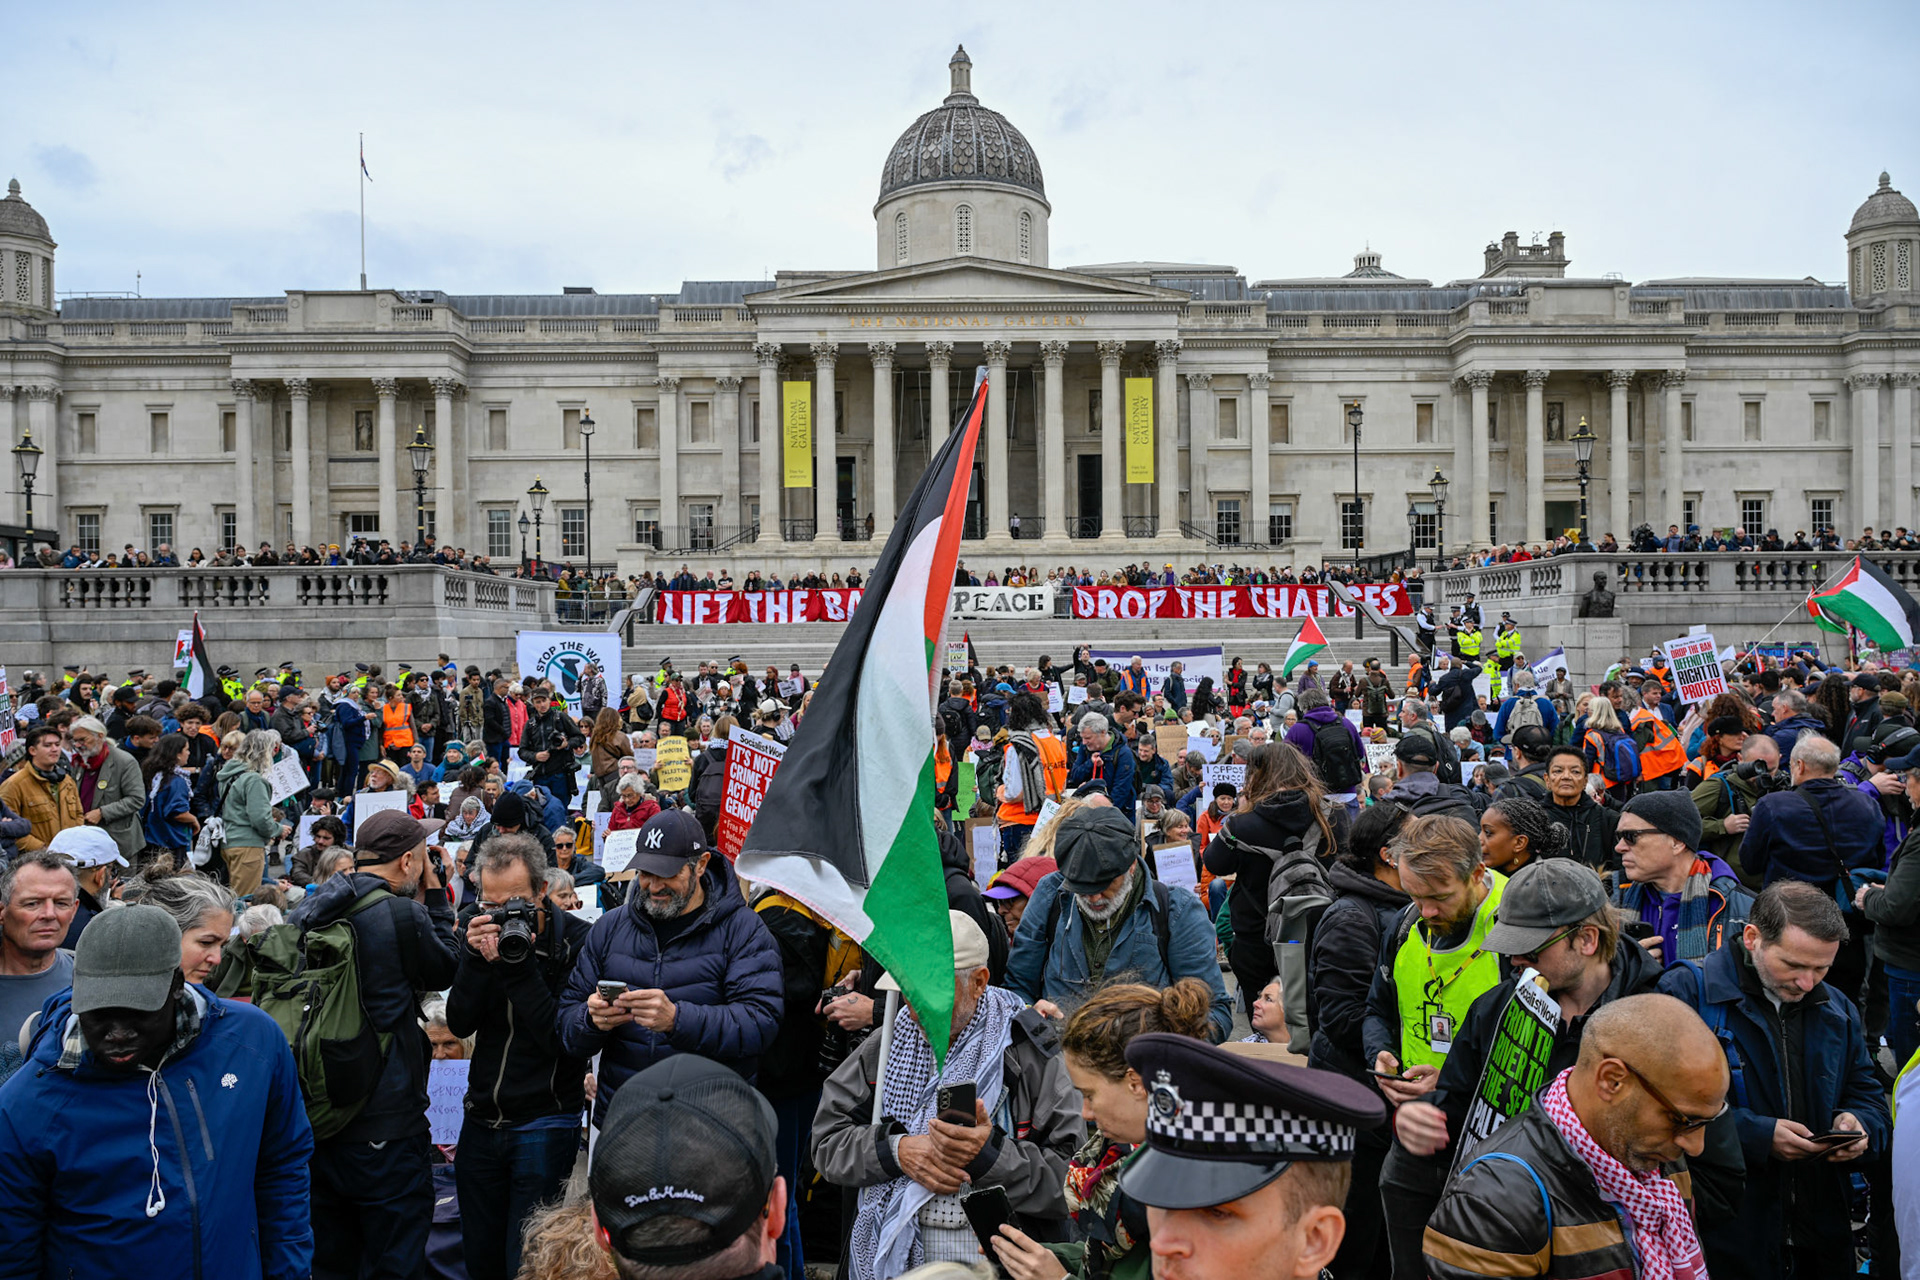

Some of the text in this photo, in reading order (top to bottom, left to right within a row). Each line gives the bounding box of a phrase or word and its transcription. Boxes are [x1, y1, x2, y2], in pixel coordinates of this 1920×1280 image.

[850, 315, 1088, 327] THE NATIONAL GALLERY
[790, 399, 798, 448] NATIONAL
[798, 399, 807, 449] GALLERY
[1132, 395, 1140, 445] NATIONAL
[1141, 396, 1149, 445] GALLERY
[664, 590, 862, 624] LIFT THE BA
[953, 591, 1044, 612] PEACE
[1074, 586, 1167, 619] DROP
[1175, 587, 1237, 618] THE
[536, 641, 605, 674] STOP THE WAR
[1671, 641, 1712, 659] DROP THE BAN
[1673, 651, 1715, 670] DEFEND THE
[1677, 663, 1720, 685] RIGHT TO
[1681, 678, 1724, 700] PROTEST
[731, 743, 776, 777] IT'S NOT
[1206, 765, 1244, 774] I OPPOS
[729, 762, 773, 794] CRIME T
[726, 779, 763, 809] ACT AG
[725, 796, 758, 824] GENOC
[645, 828, 664, 849] NY
[726, 819, 739, 833] Free
[1503, 998, 1554, 1066] FROM TH
[1492, 1030, 1544, 1092] RIVER TO
[432, 1085, 466, 1098] GENOC
[1482, 1063, 1506, 1109] THE
